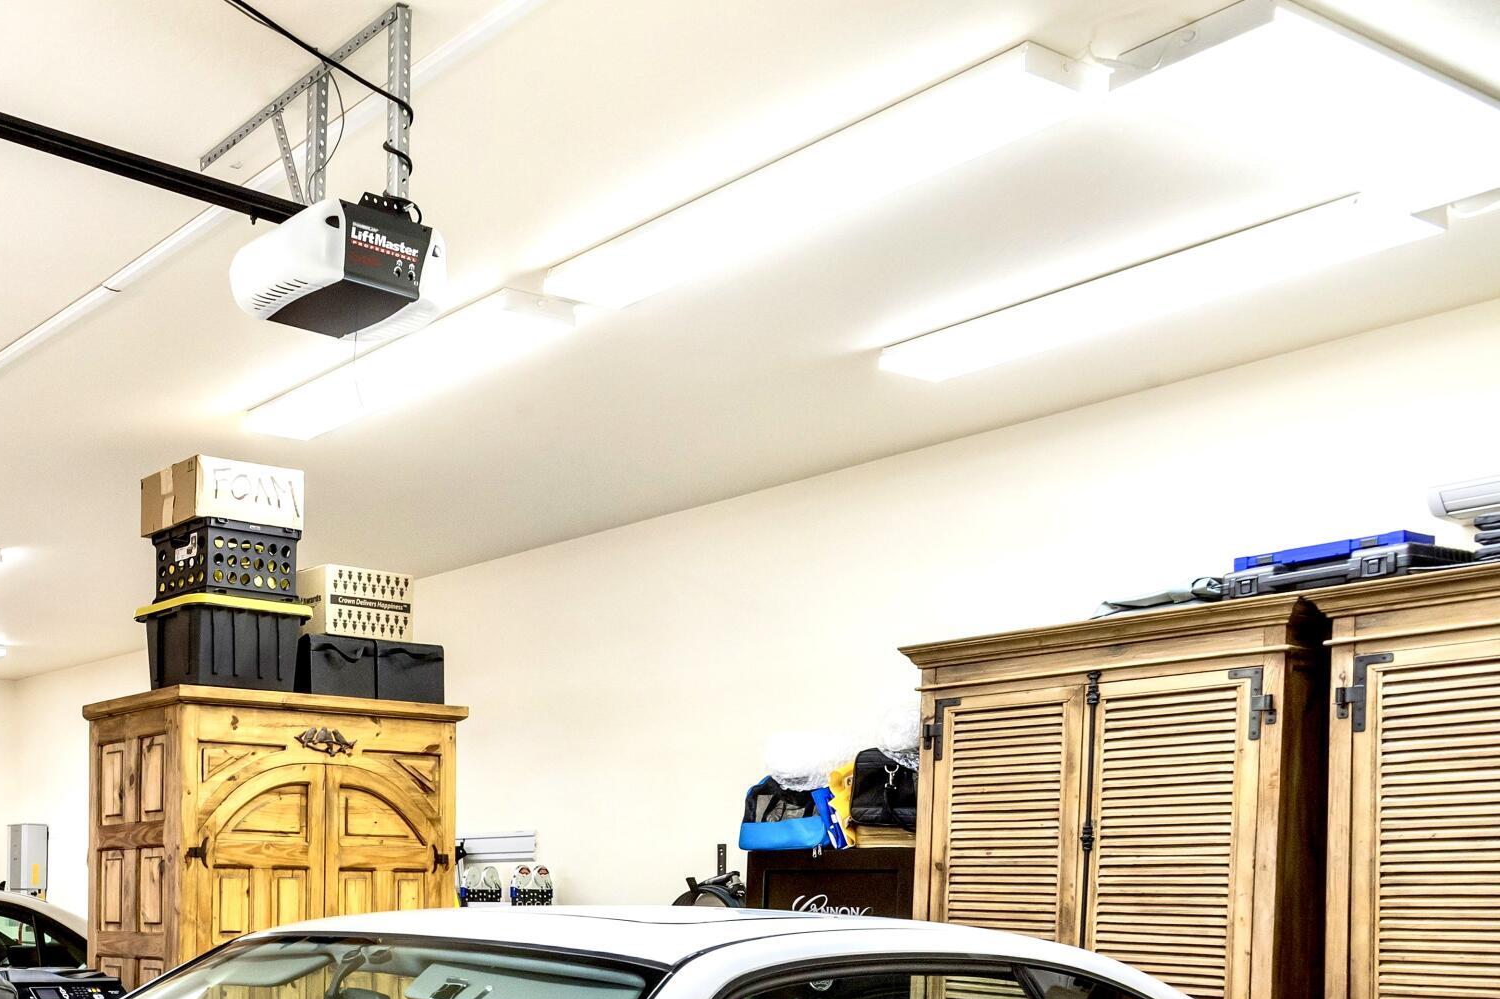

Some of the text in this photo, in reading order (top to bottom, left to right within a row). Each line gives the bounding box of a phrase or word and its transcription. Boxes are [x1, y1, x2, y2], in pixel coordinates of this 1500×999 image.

[212, 467, 300, 518] FOAM
[338, 596, 356, 606] Crown
[356, 598, 377, 608] Delivers
